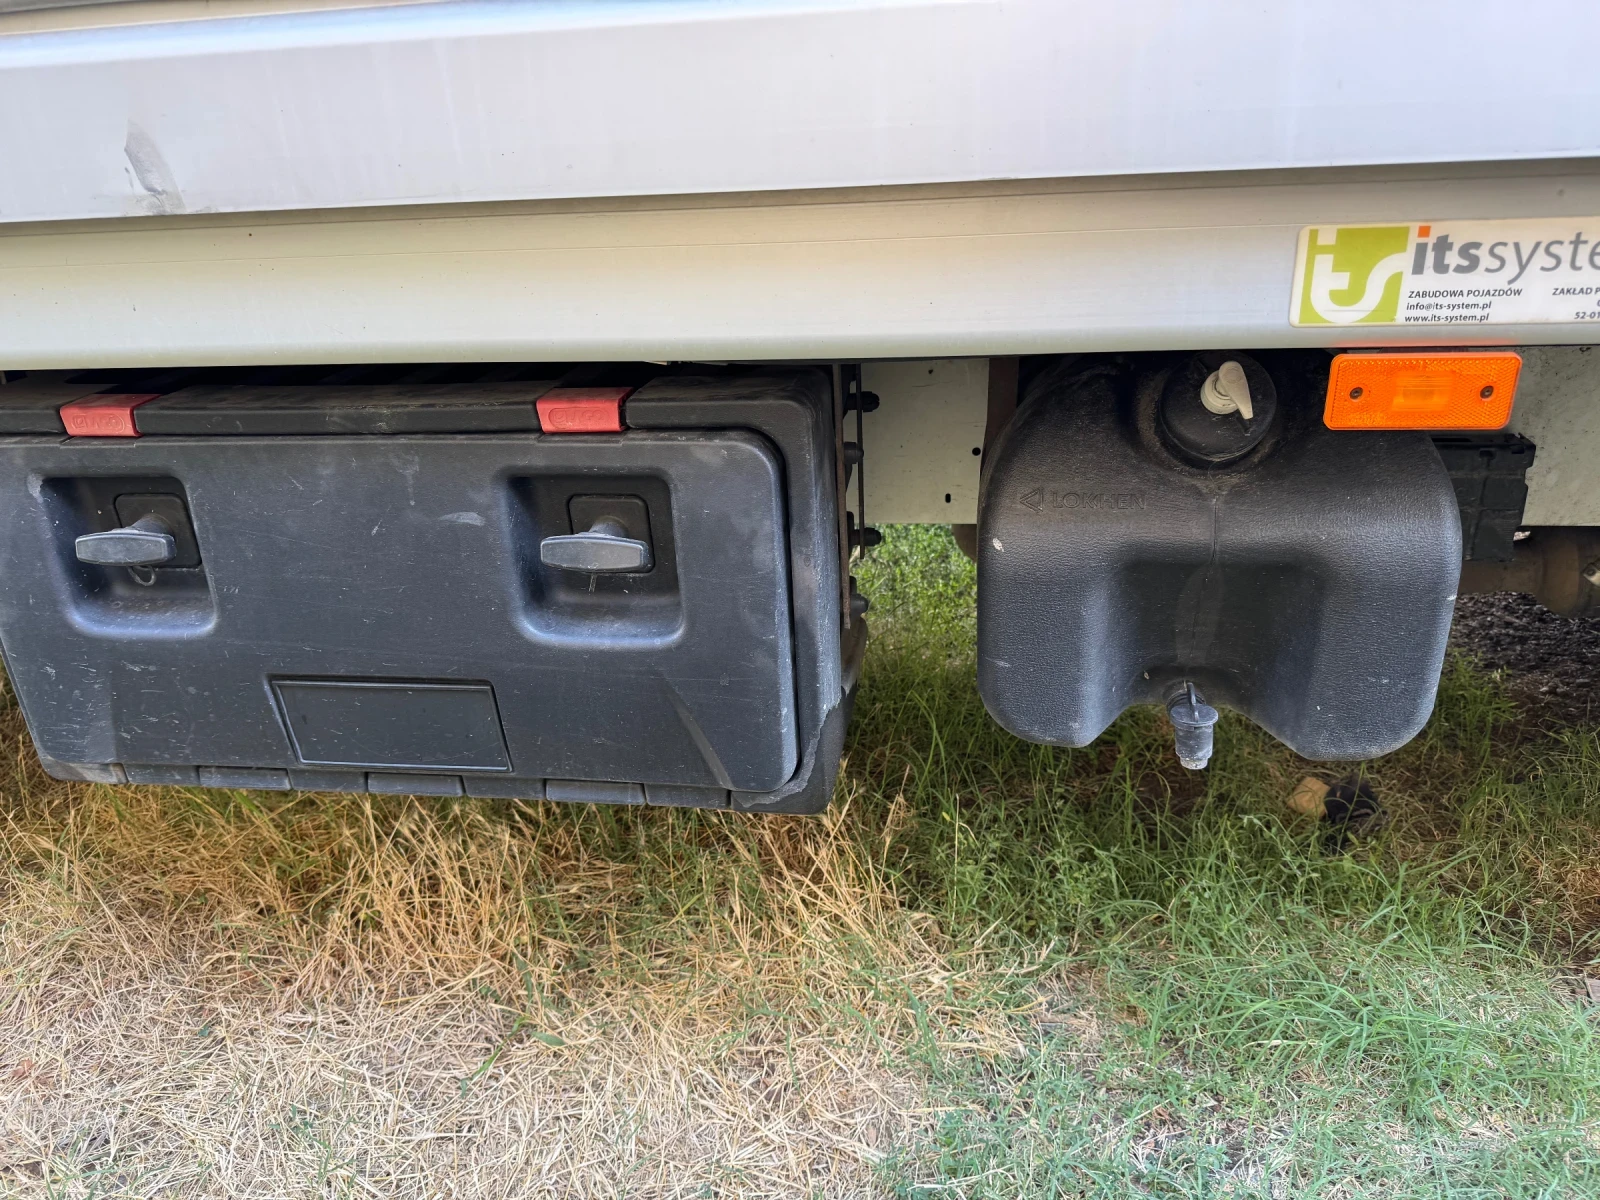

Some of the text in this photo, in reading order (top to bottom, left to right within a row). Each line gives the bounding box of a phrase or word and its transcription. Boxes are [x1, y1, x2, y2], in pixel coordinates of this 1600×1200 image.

[1408, 287, 1523, 299] ZABUDOWA POJAZDÓW
[1552, 287, 1593, 296] ZAKŁAD
[1406, 300, 1492, 312] info@its-system.pl
[1404, 313, 1489, 324] www.its-system.pl
[1051, 491, 1147, 510] LOKHEN
